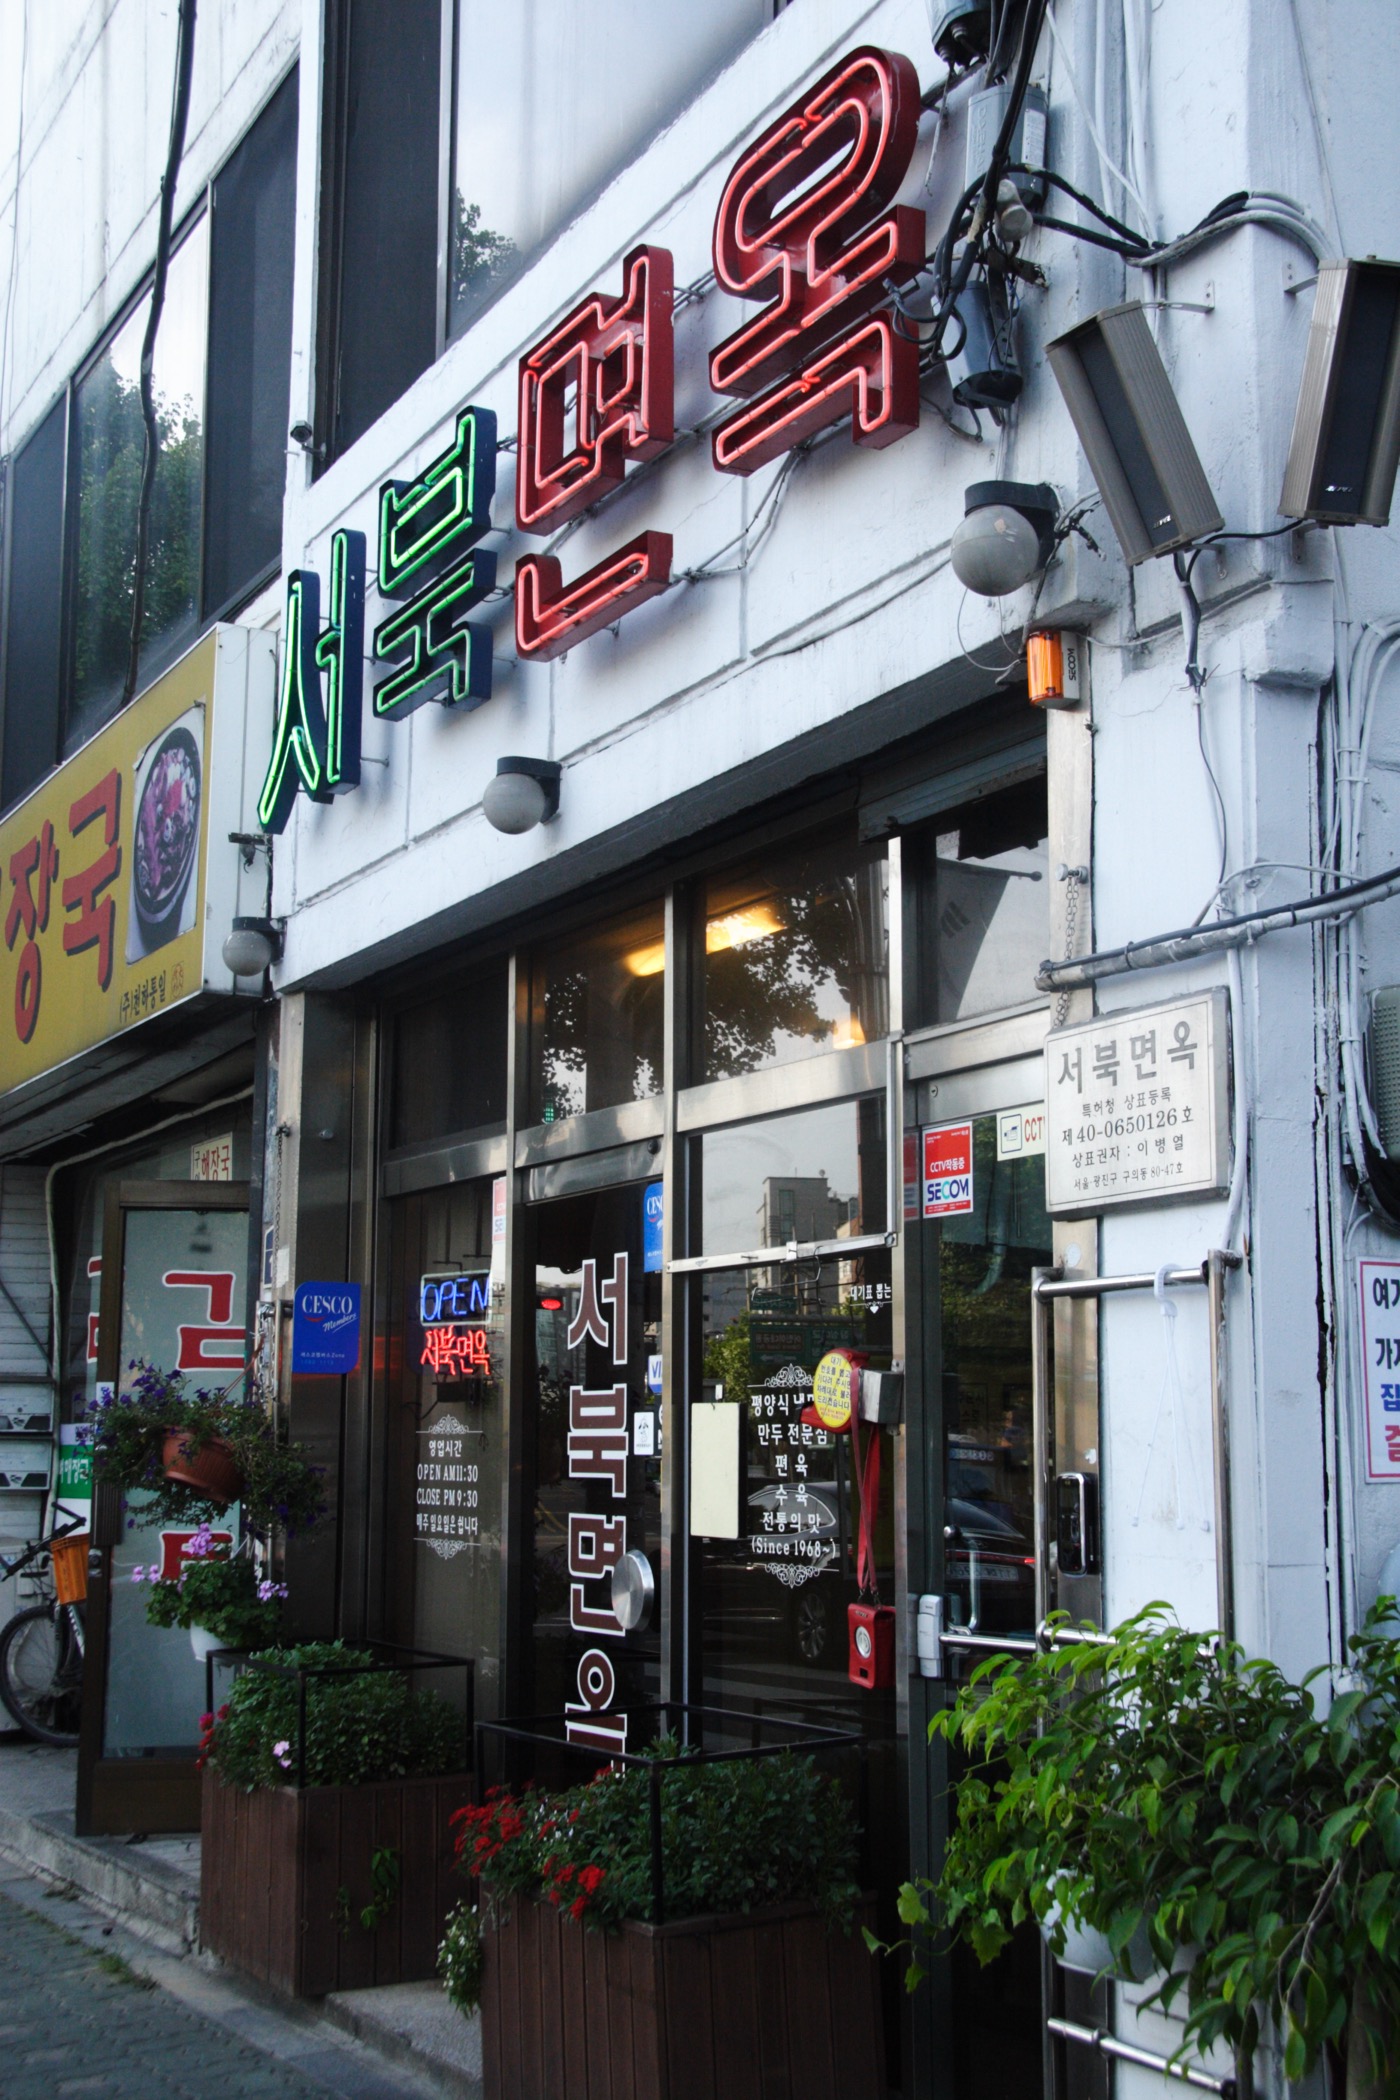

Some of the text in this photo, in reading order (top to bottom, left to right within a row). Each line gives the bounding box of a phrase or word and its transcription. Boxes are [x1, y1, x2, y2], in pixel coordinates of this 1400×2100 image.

[258, 45, 926, 835] 서북면옥
[1066, 647, 1077, 681] SECOM
[0, 767, 121, 1044] 장국
[1057, 1020, 1198, 1095] 서북면옥
[1082, 1086, 1172, 1119] 특허청 상표등록
[1024, 1116, 1045, 1143] CCT
[201, 1144, 231, 1181] 해장국
[929, 1156, 965, 1173] CCTV작동중
[1072, 1145, 1121, 1169] 상표권자
[1122, 1166, 1148, 1184] 구의동
[1149, 1162, 1184, 1178] 80-47호
[927, 1177, 969, 1203] SECOM
[420, 1276, 491, 1321] OPEN
[850, 1284, 873, 1301] 대기표
[301, 1294, 353, 1315] CESCO
[322, 1313, 357, 1332] Members
[420, 1324, 491, 1376] 서북면옥
[651, 1360, 663, 1379] VI
[820, 1365, 836, 1376] 번호를
[750, 1393, 789, 1417] 평양식
[757, 1423, 783, 1446] 만두
[428, 1439, 463, 1458] 영업시간
[417, 1463, 441, 1481] OPEN
[416, 1487, 441, 1507] CLOSE
[416, 1512, 430, 1532] 매주
[566, 1251, 628, 1779] 서북면옥
[762, 1511, 821, 1534] 전통의 맛
[751, 1535, 790, 1555] (Since
